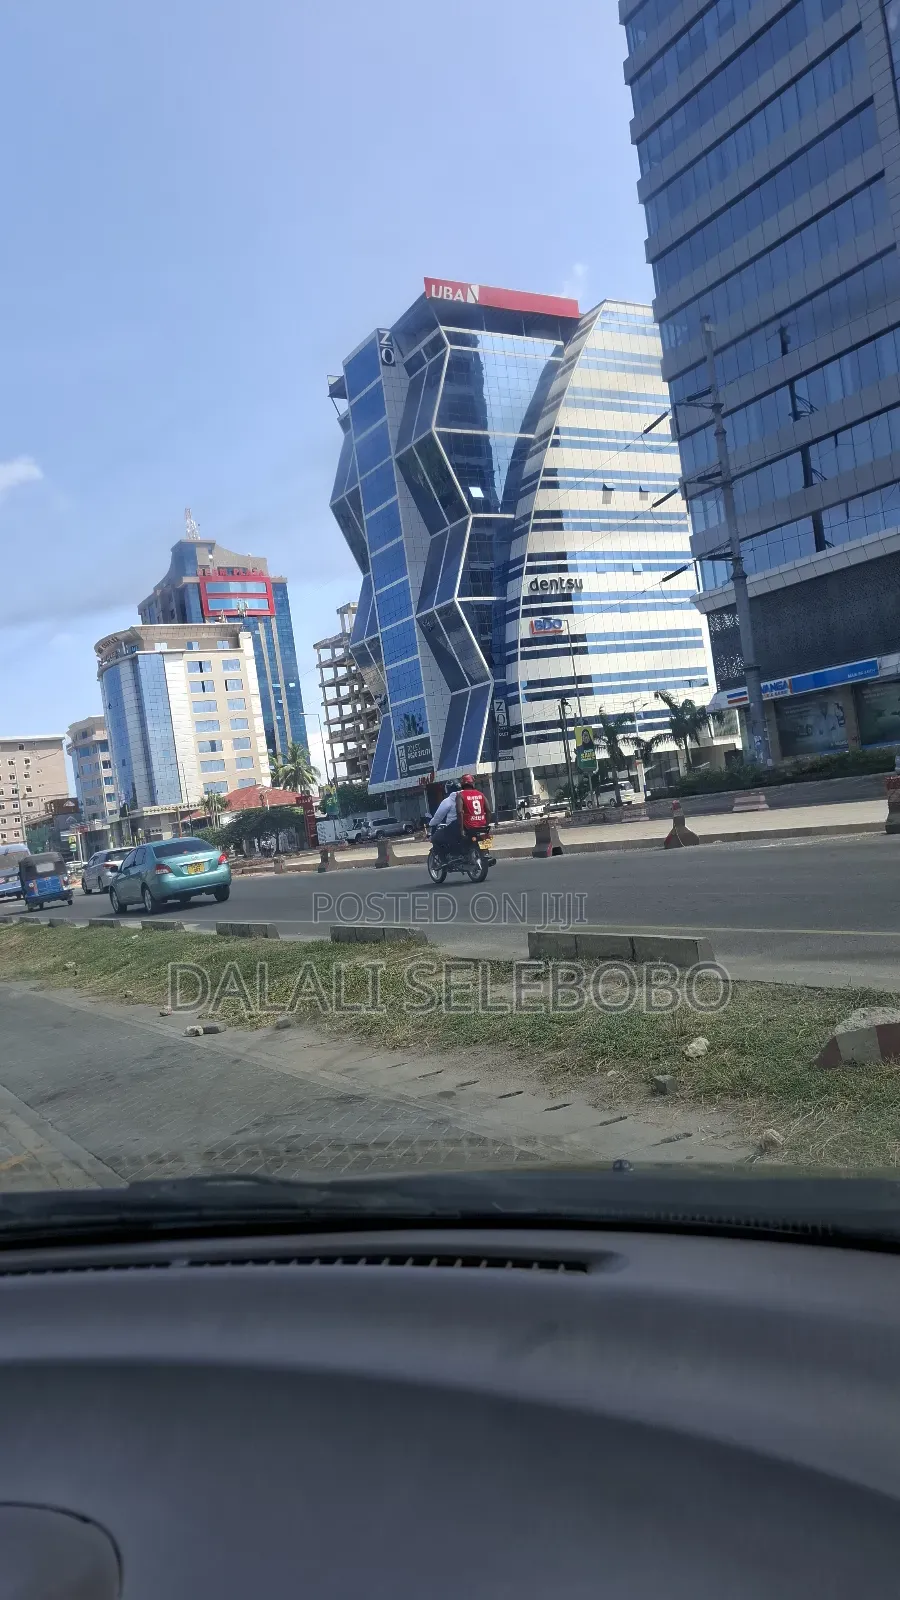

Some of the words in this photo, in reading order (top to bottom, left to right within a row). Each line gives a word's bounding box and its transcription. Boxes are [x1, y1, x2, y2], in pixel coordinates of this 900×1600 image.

[431, 284, 465, 302] UBA
[529, 576, 583, 592] dentsu
[534, 618, 563, 630] BDO
[472, 800, 482, 815] 9
